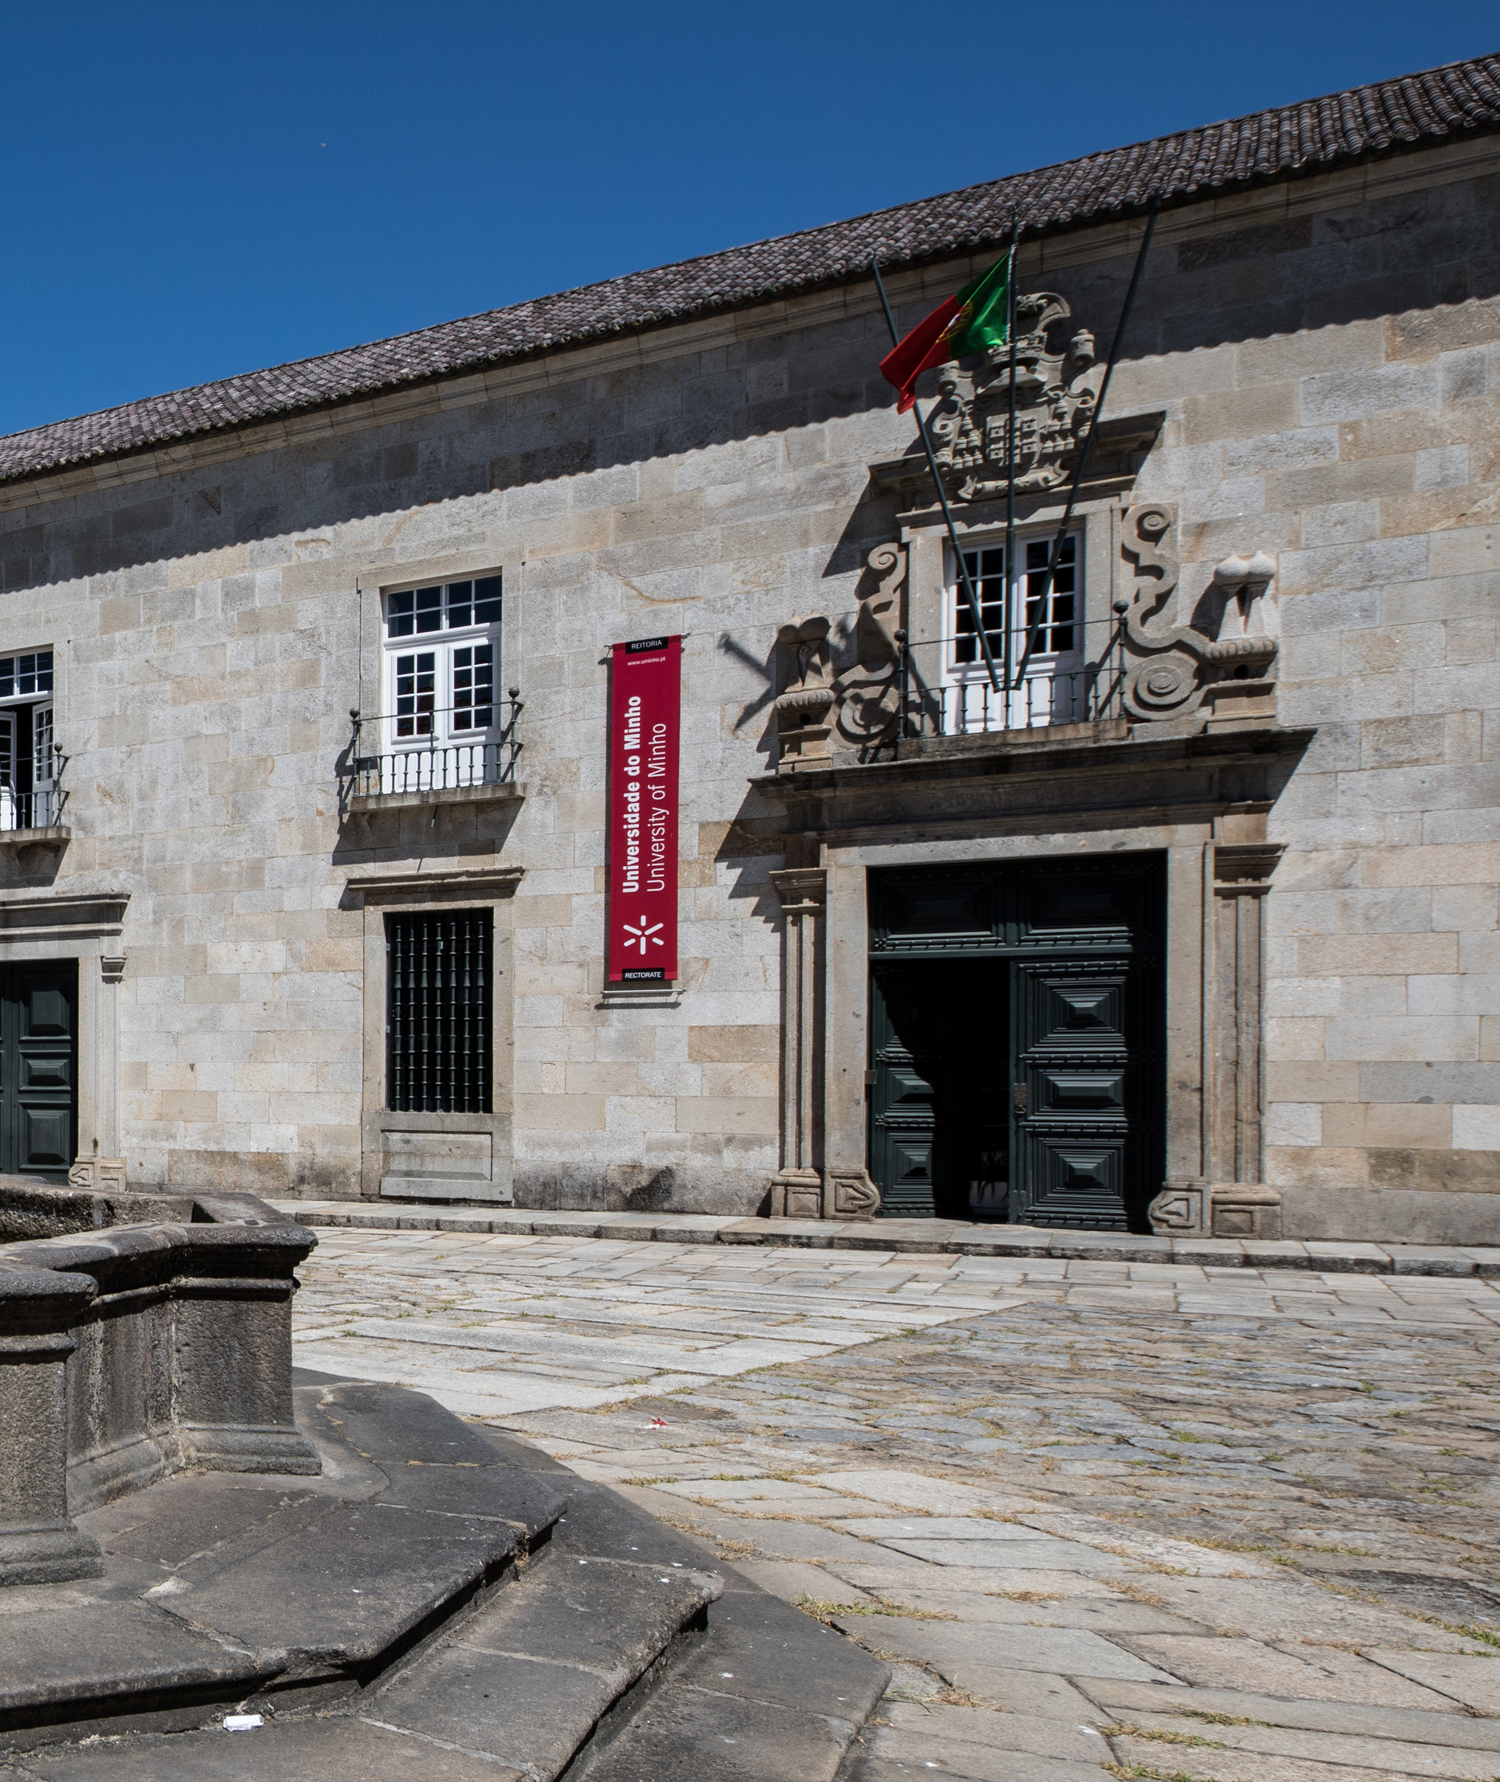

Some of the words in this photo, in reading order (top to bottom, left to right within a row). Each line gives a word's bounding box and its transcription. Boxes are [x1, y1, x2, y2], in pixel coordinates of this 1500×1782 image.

[631, 640, 662, 650] REITORIA
[627, 656, 666, 666] www.uminho.pt
[623, 696, 641, 751] Minho
[647, 723, 667, 778] Minho
[623, 755, 641, 777] do
[647, 784, 666, 801] of
[622, 782, 640, 893] Universidade
[646, 807, 670, 892] University
[624, 971, 662, 979] RECTORATE
